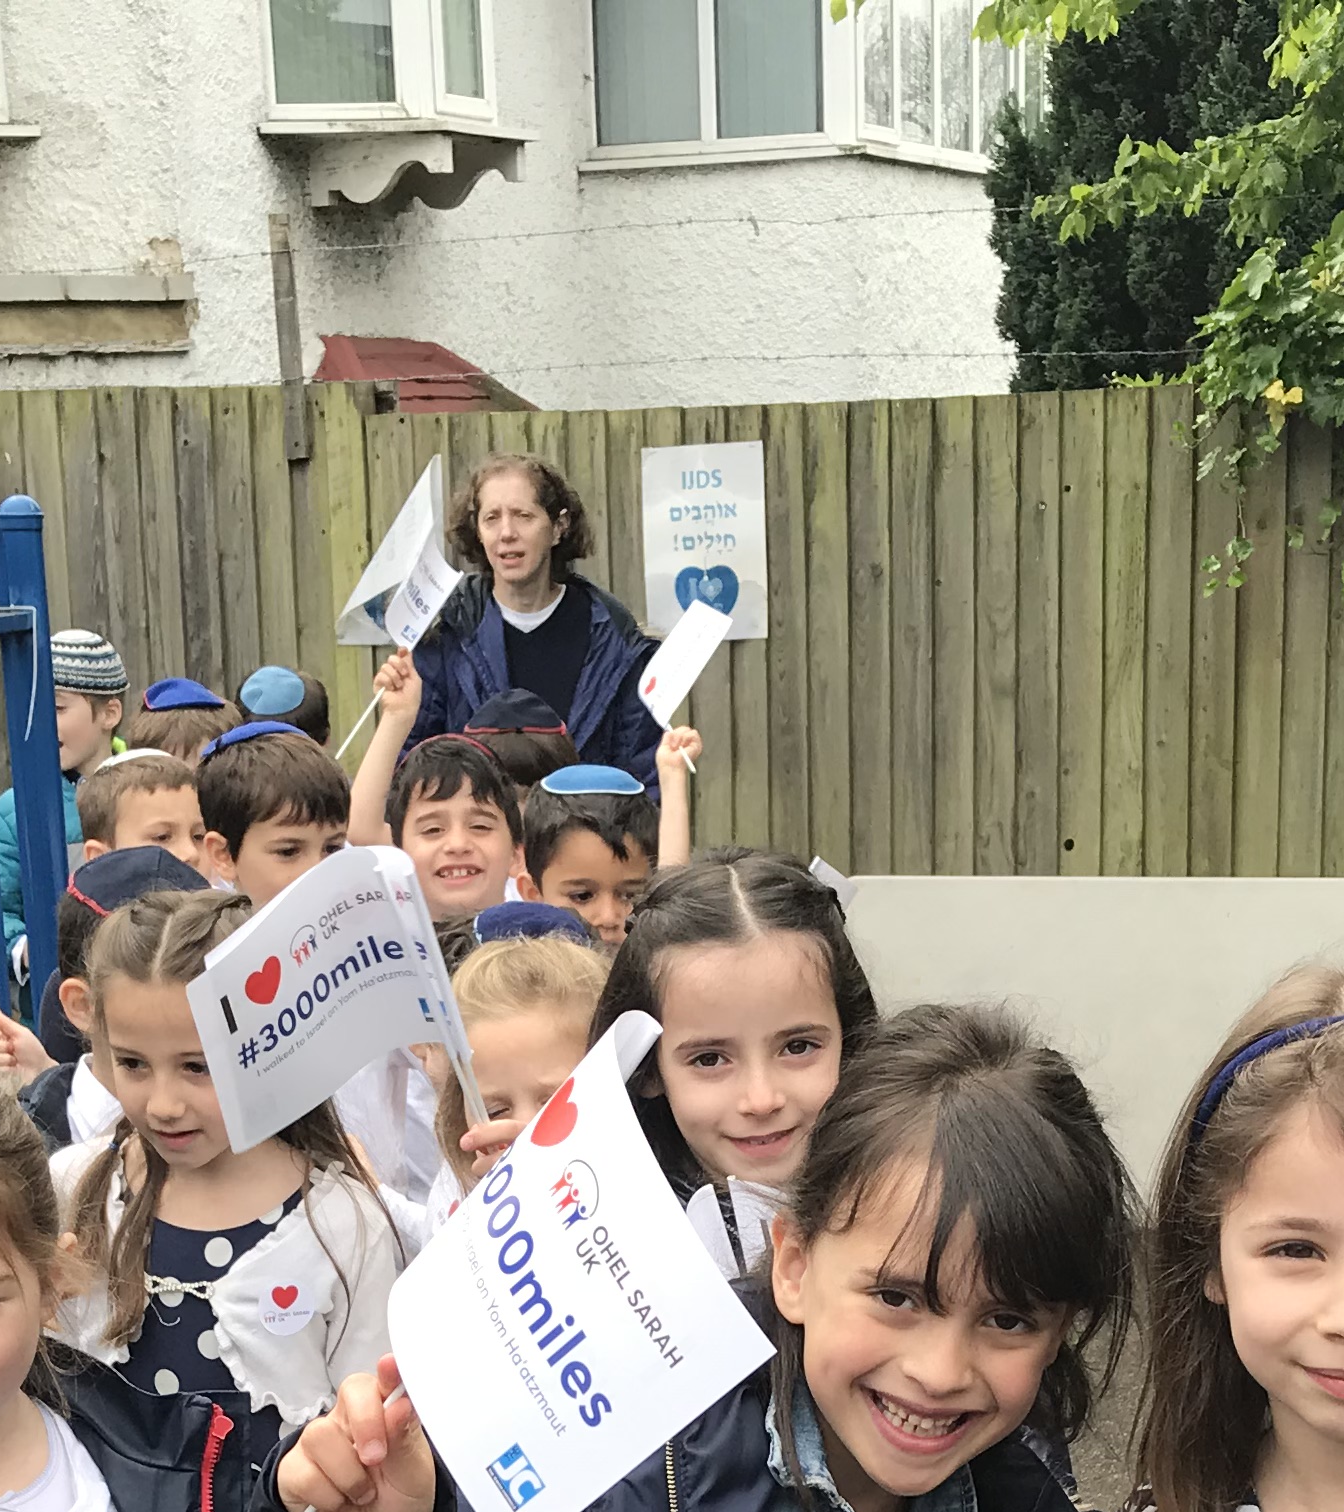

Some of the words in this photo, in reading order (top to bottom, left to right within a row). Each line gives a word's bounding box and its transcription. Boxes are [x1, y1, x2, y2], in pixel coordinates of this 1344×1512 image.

[318, 901, 355, 929] OHEL
[322, 921, 341, 941] UK
[219, 993, 239, 1035] I
[237, 934, 405, 1070] #3000mile
[262, 1045, 295, 1073] walked
[296, 1037, 306, 1049] to
[306, 1015, 328, 1040] Israel
[338, 988, 358, 1006] Yom
[576, 1237, 601, 1276] UK
[592, 1226, 631, 1290] OHEL
[627, 1289, 685, 1369] SARAH
[476, 1277, 489, 1300] on
[486, 1298, 507, 1339] Yom
[504, 1337, 568, 1438] Ha'atzmaut
